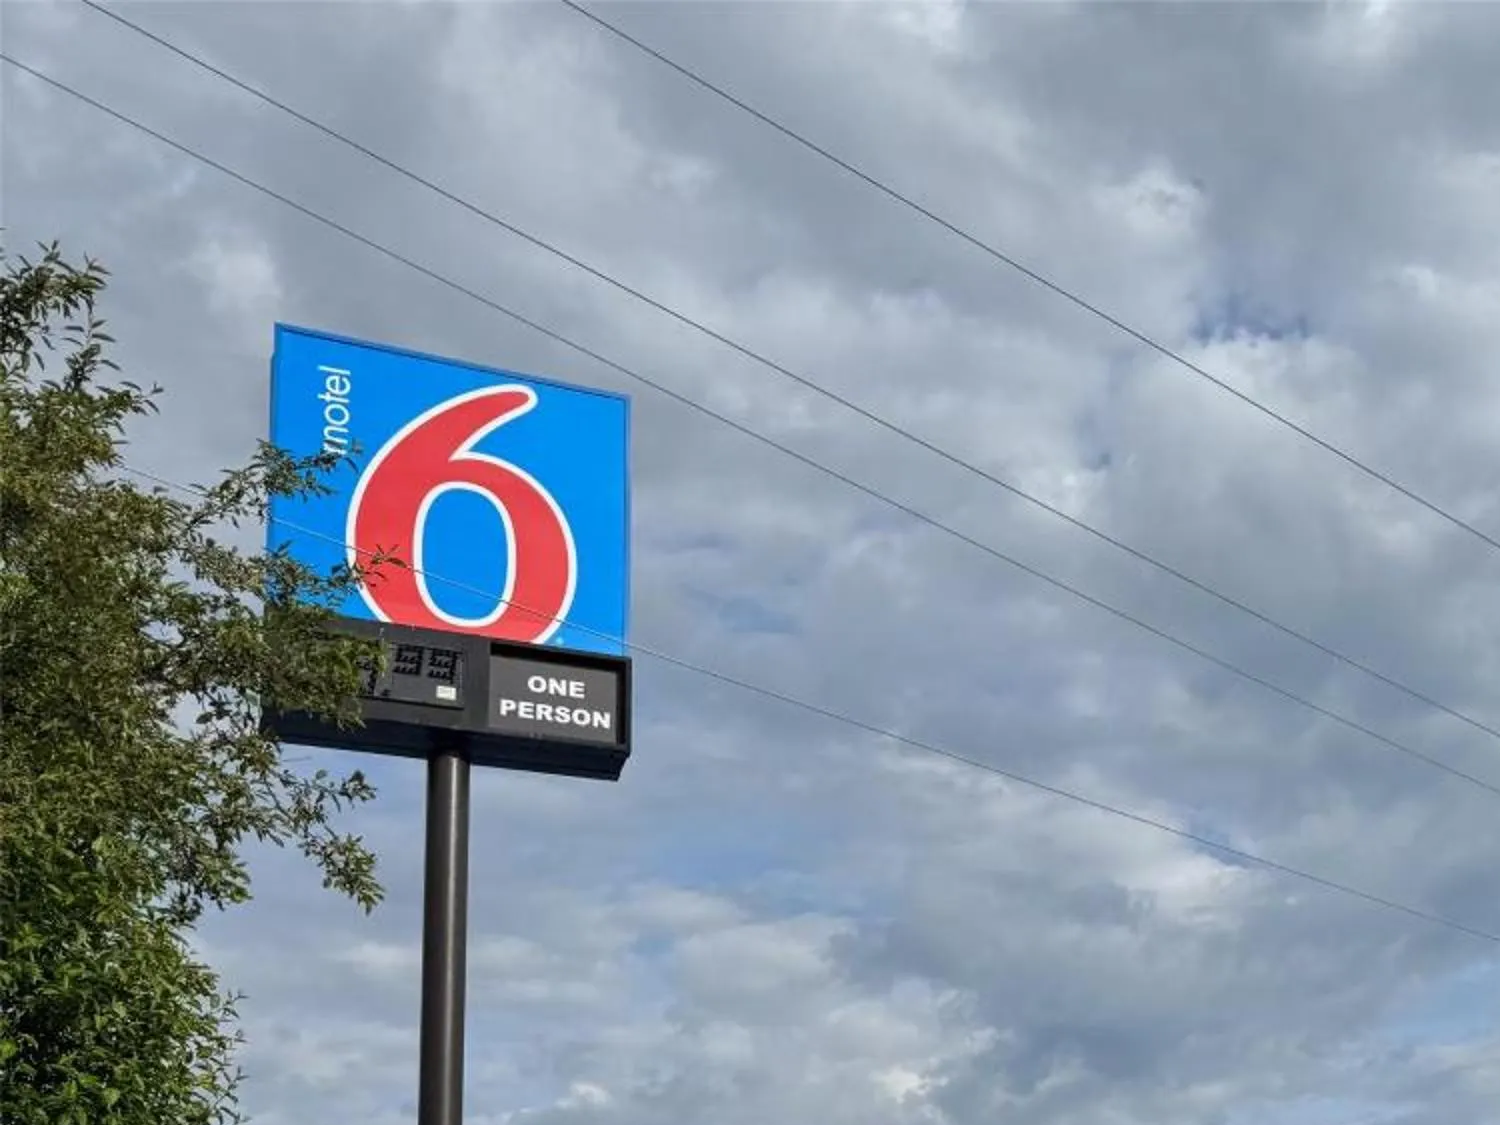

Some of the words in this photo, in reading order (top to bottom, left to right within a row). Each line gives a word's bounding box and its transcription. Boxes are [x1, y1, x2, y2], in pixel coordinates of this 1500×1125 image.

[345, 383, 577, 645] 6
[527, 675, 585, 698] ONE
[500, 699, 611, 729] PERSON
